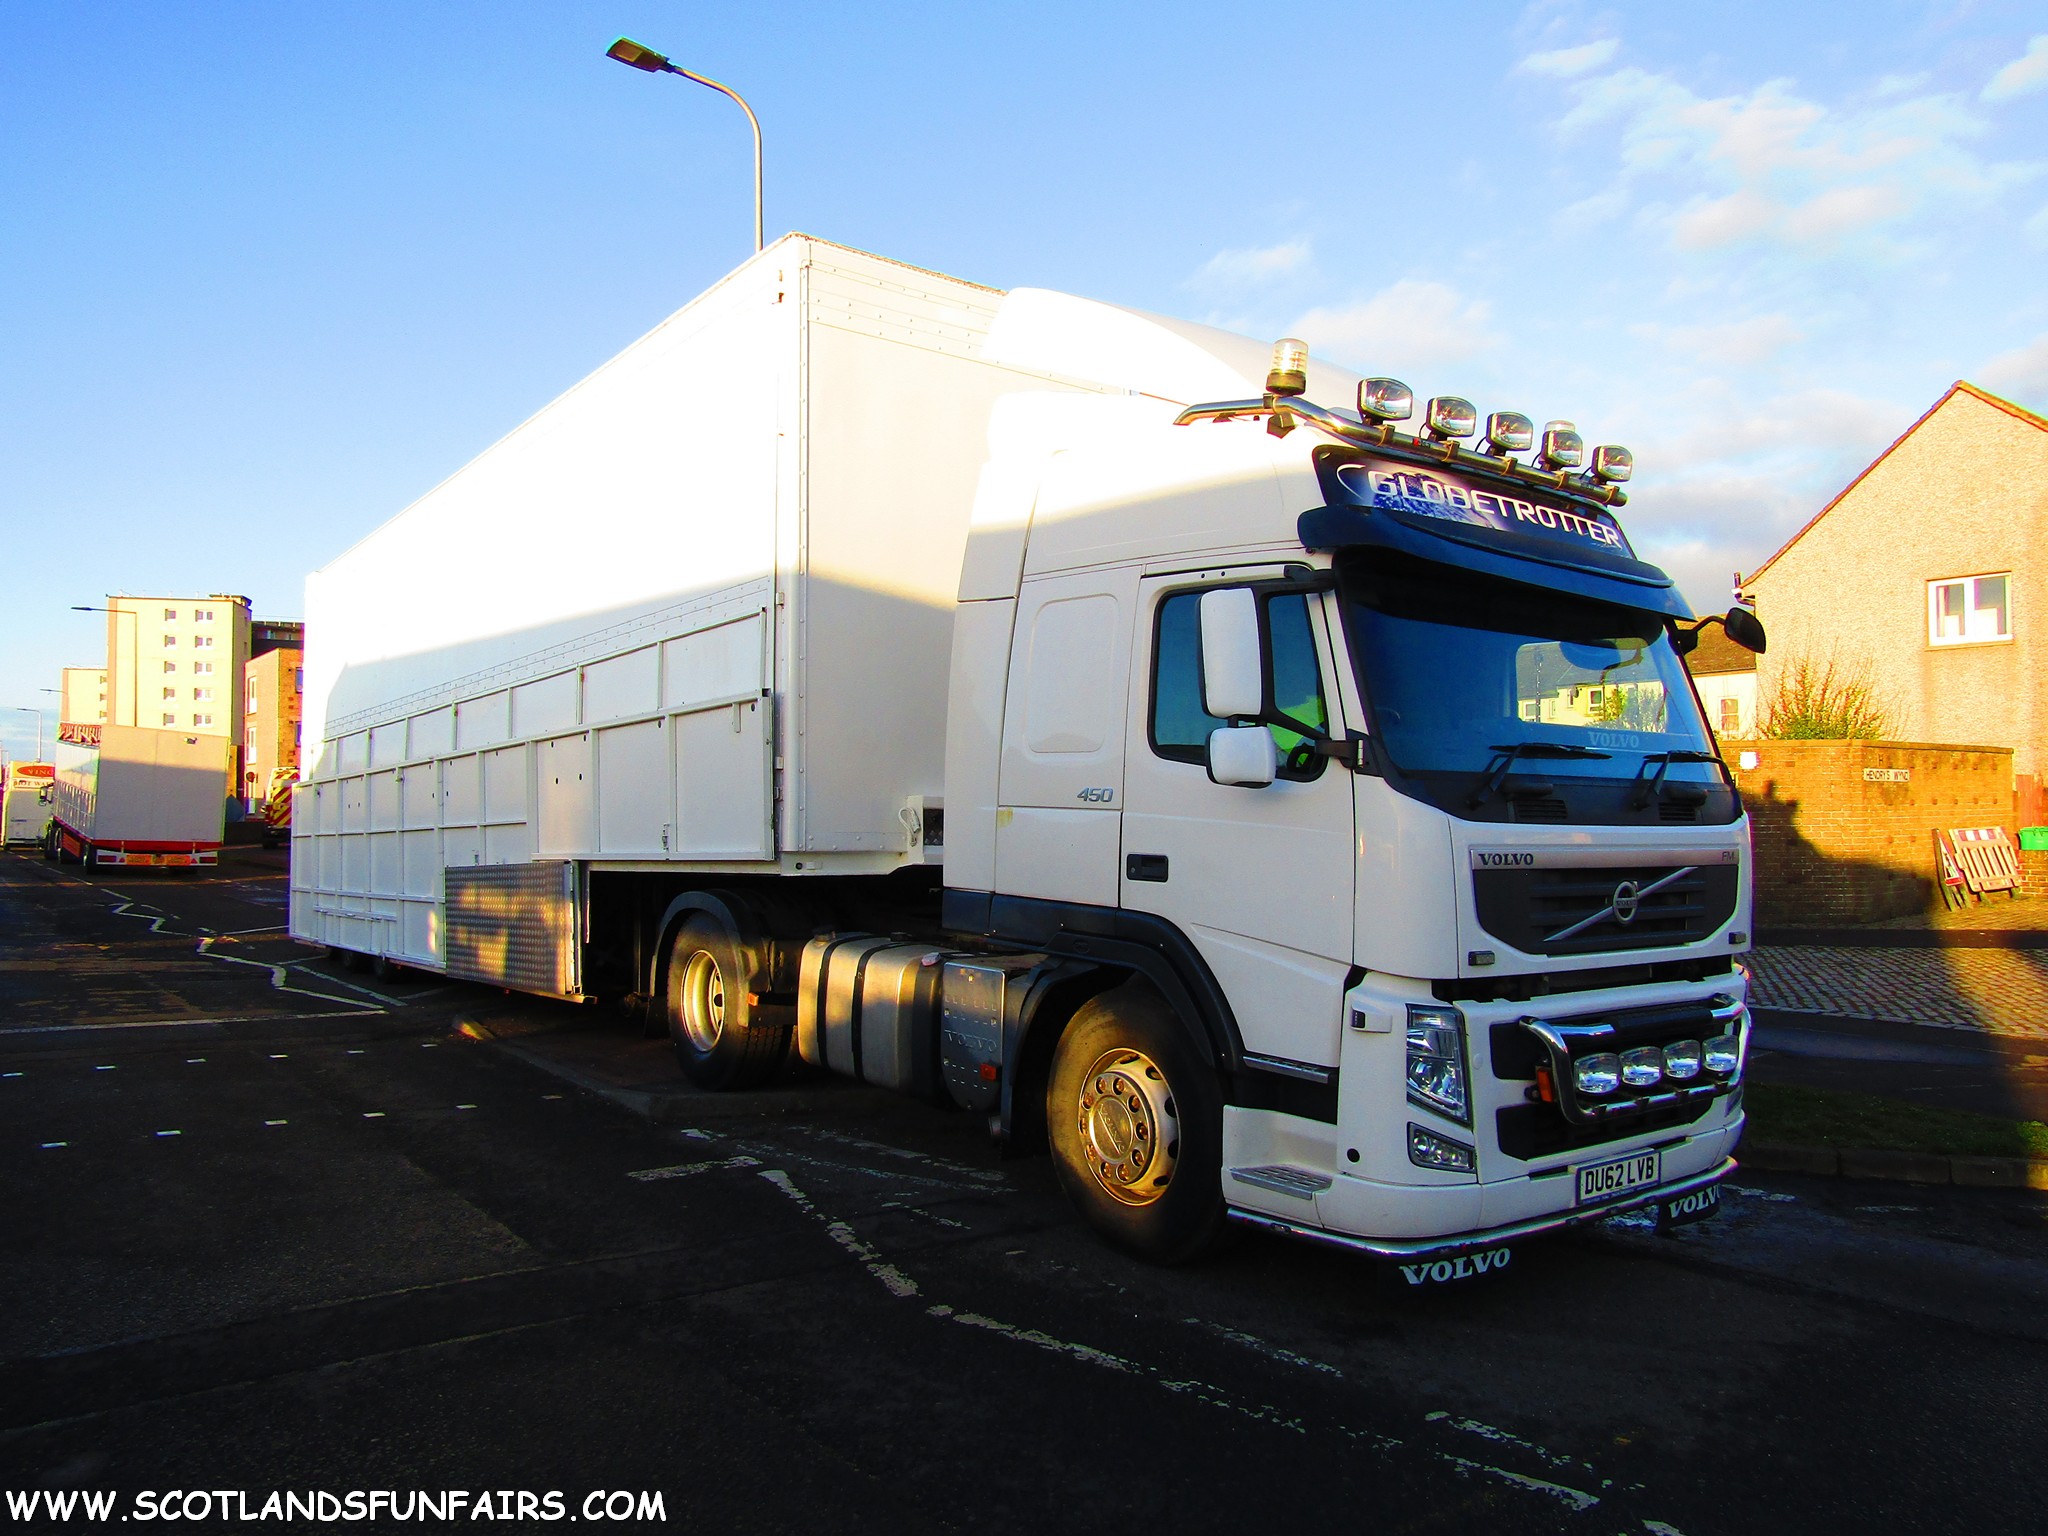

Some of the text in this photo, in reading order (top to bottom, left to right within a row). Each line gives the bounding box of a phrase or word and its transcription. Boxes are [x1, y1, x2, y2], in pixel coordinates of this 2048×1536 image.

[1367, 470, 1623, 549] GLOBETROTTER
[1588, 731, 1640, 748] VOLVO
[1077, 787, 1114, 802] 450
[1478, 851, 1735, 866] VOLVO FM
[1585, 1164, 1624, 1195] DU62
[1627, 1156, 1655, 1184] LVB
[1399, 1247, 1511, 1285] VOLVO
